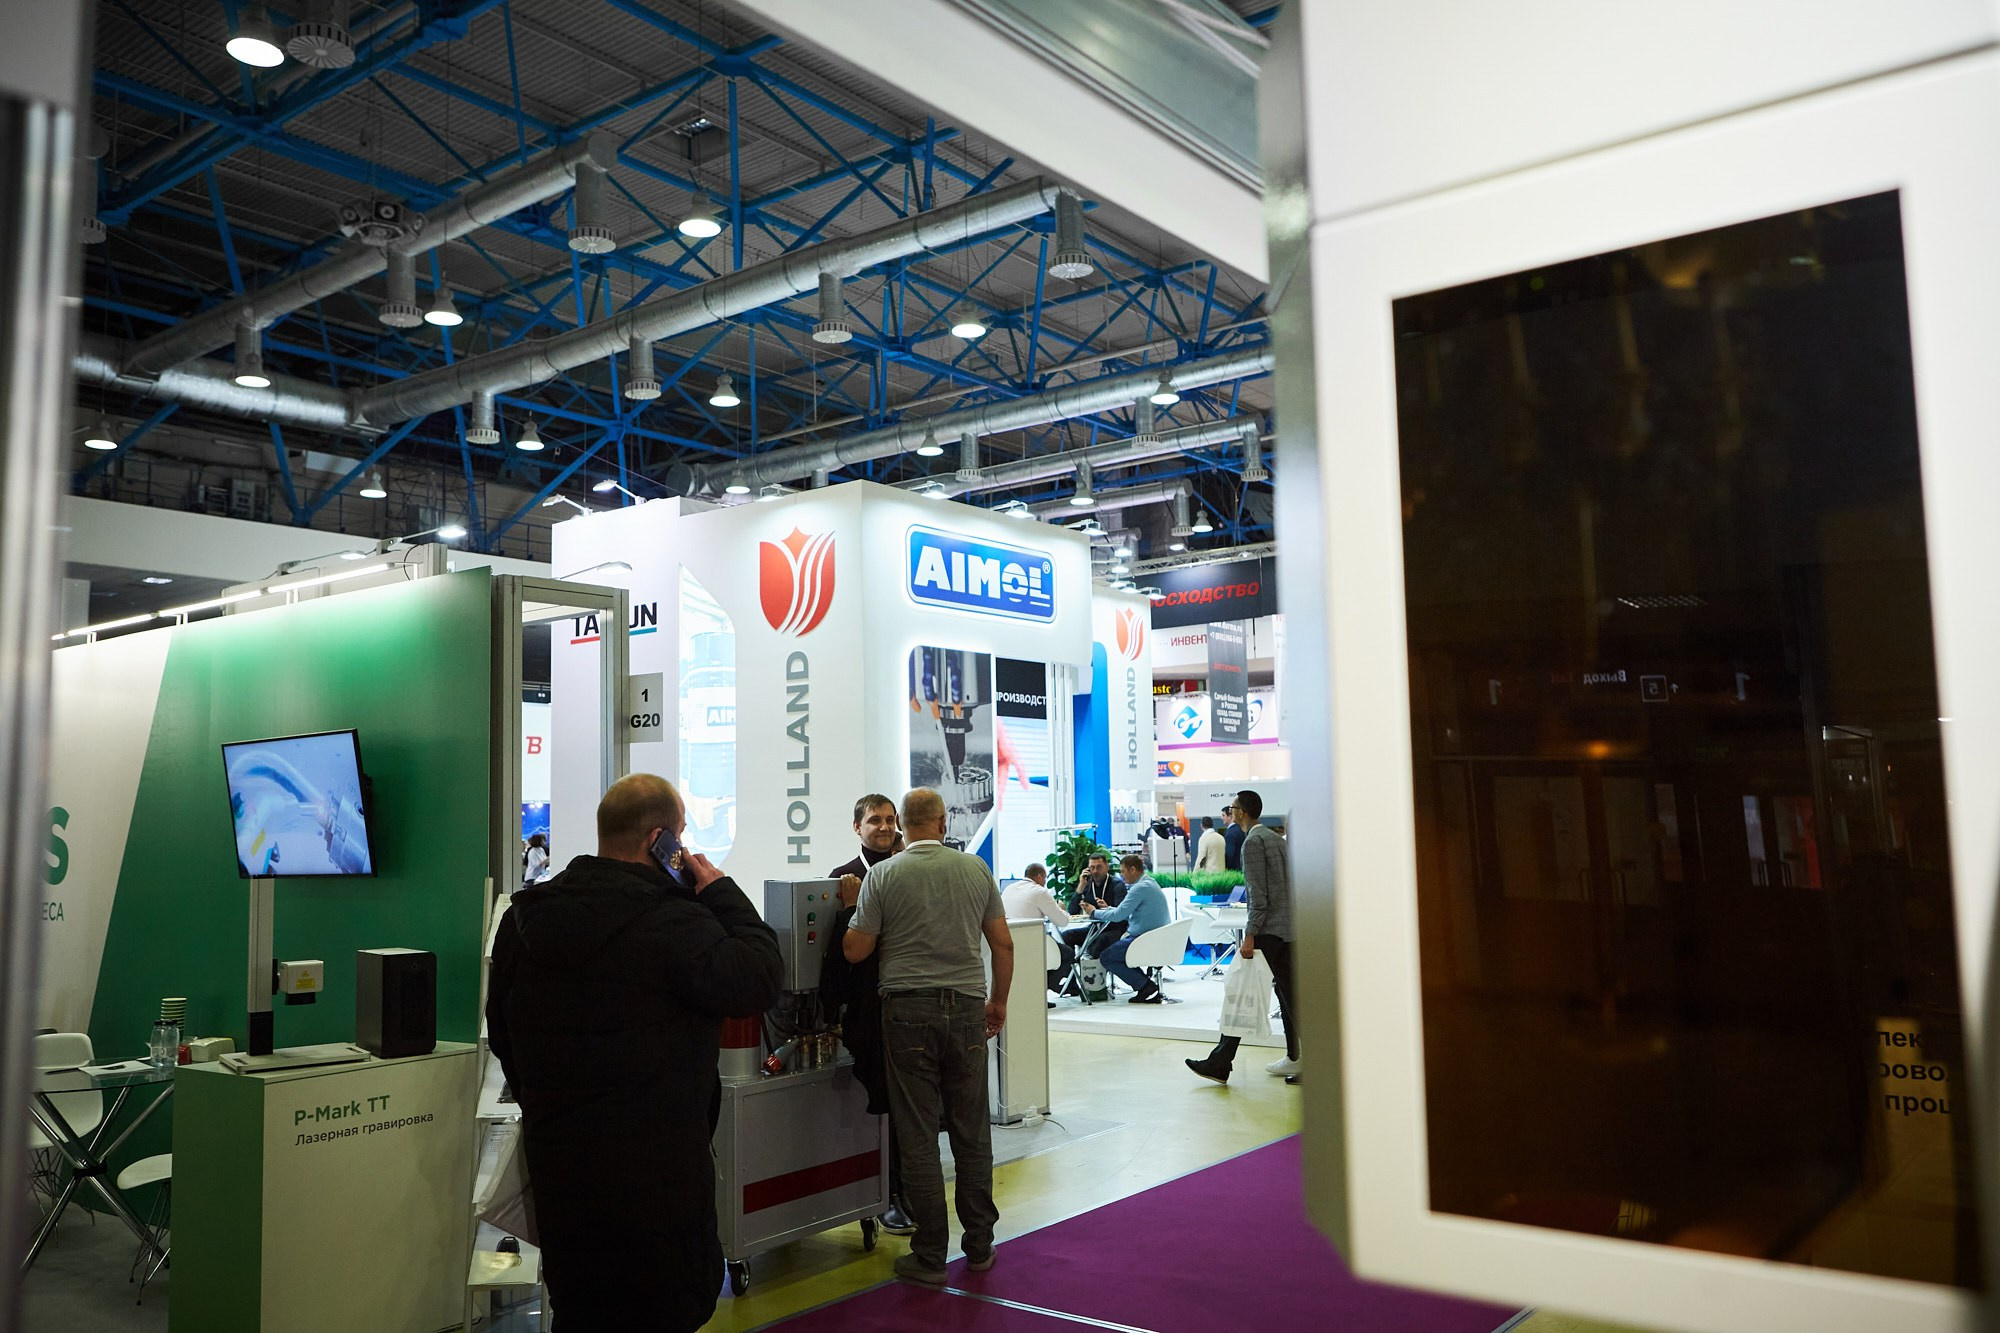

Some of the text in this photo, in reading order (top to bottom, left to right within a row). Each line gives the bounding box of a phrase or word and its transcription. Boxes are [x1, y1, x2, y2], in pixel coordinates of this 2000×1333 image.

[914, 545, 1051, 607] AIMOL
[1151, 581, 1260, 608] ОСХОДСТВО
[641, 689, 649, 702] 1
[630, 712, 661, 728] G20
[1126, 666, 1138, 769] HOLLAND
[786, 650, 811, 864] HOLLAND
[294, 1095, 391, 1126] P-Mark TT
[295, 1113, 434, 1146] Лазерная гравировка
